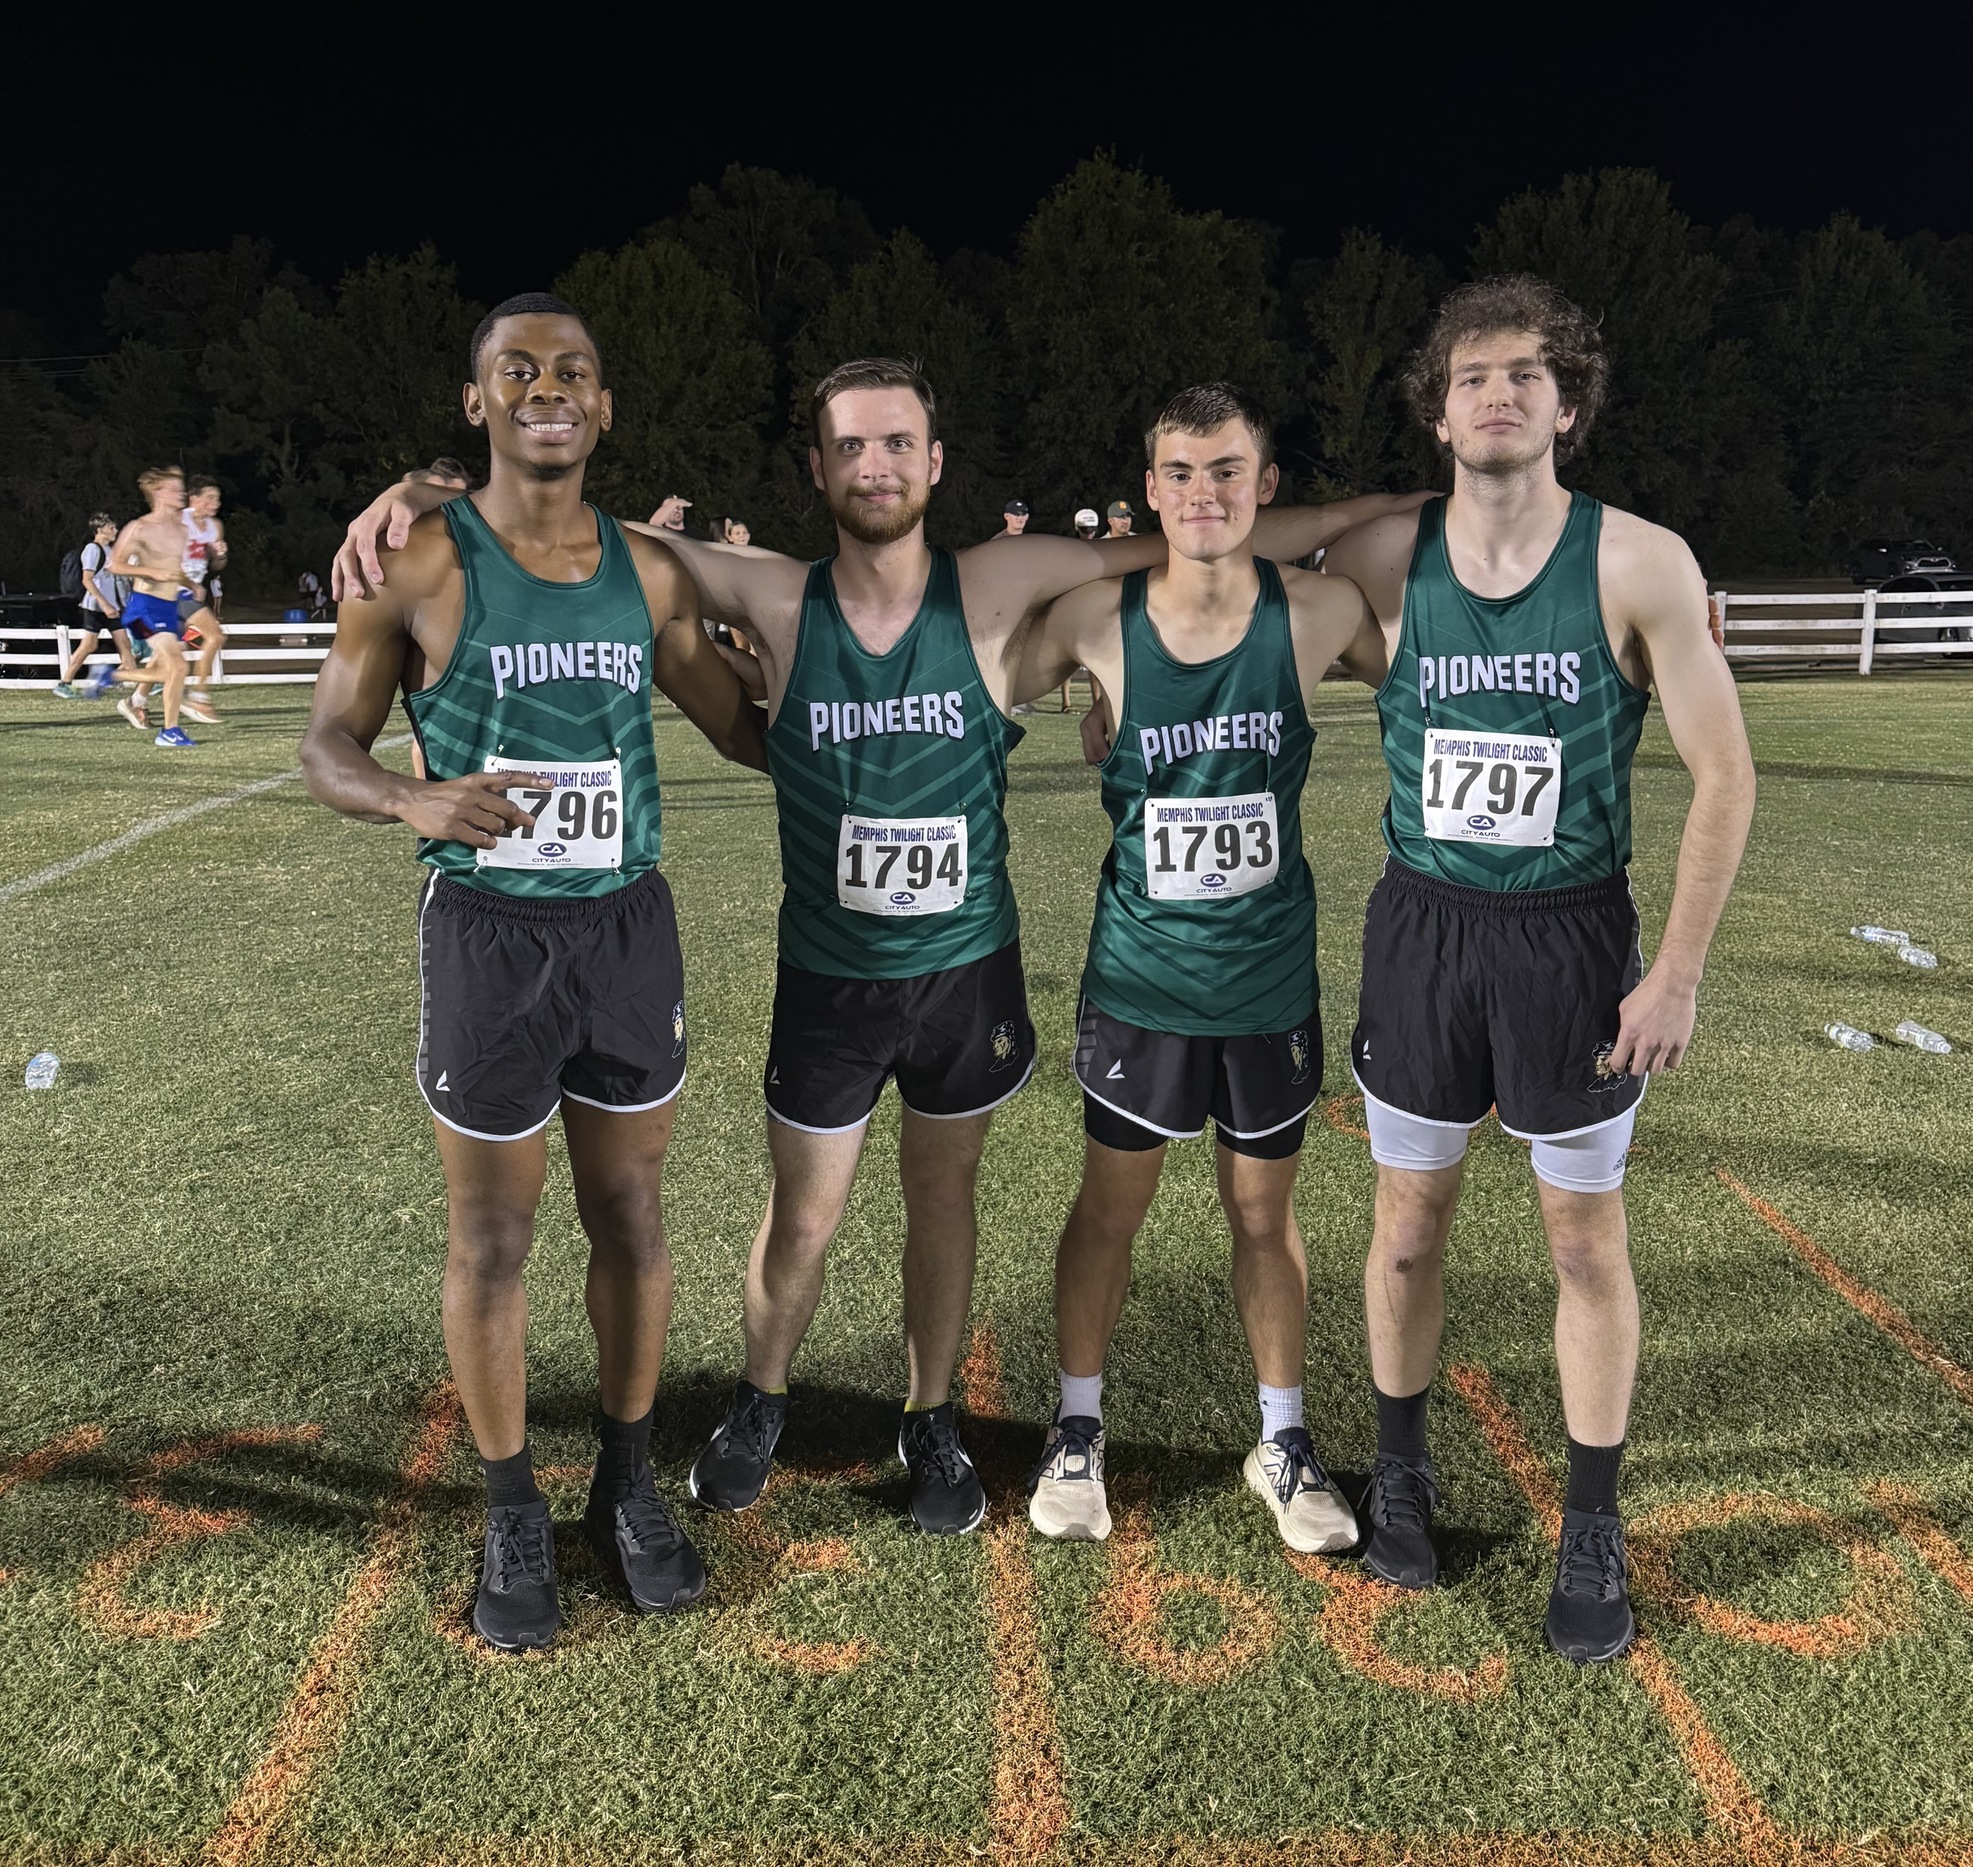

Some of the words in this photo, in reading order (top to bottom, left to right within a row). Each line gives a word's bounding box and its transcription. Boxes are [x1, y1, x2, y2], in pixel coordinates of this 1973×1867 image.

[489, 641, 643, 700] PIONEERS
[1418, 651, 1582, 708] PIONEERS
[809, 690, 966, 752] PIONEERS
[1139, 711, 1283, 775] PIONEERS
[1433, 739, 1470, 757] MEMPHIS
[1472, 741, 1511, 760] TWILIGHT
[1512, 744, 1548, 763] CLASSIC
[580, 770, 612, 788] CLASSIC
[1426, 758, 1554, 817] 1797
[851, 824, 888, 842] MEMPHIS
[890, 828, 925, 842] TWILIGHT
[926, 824, 957, 841] CLASSIC
[1157, 807, 1193, 822] MEMPHIS
[1194, 806, 1230, 822] TWILIGHT
[1231, 802, 1264, 819] CLASSIC
[845, 842, 963, 890] 1794
[1153, 820, 1273, 873] 1793
